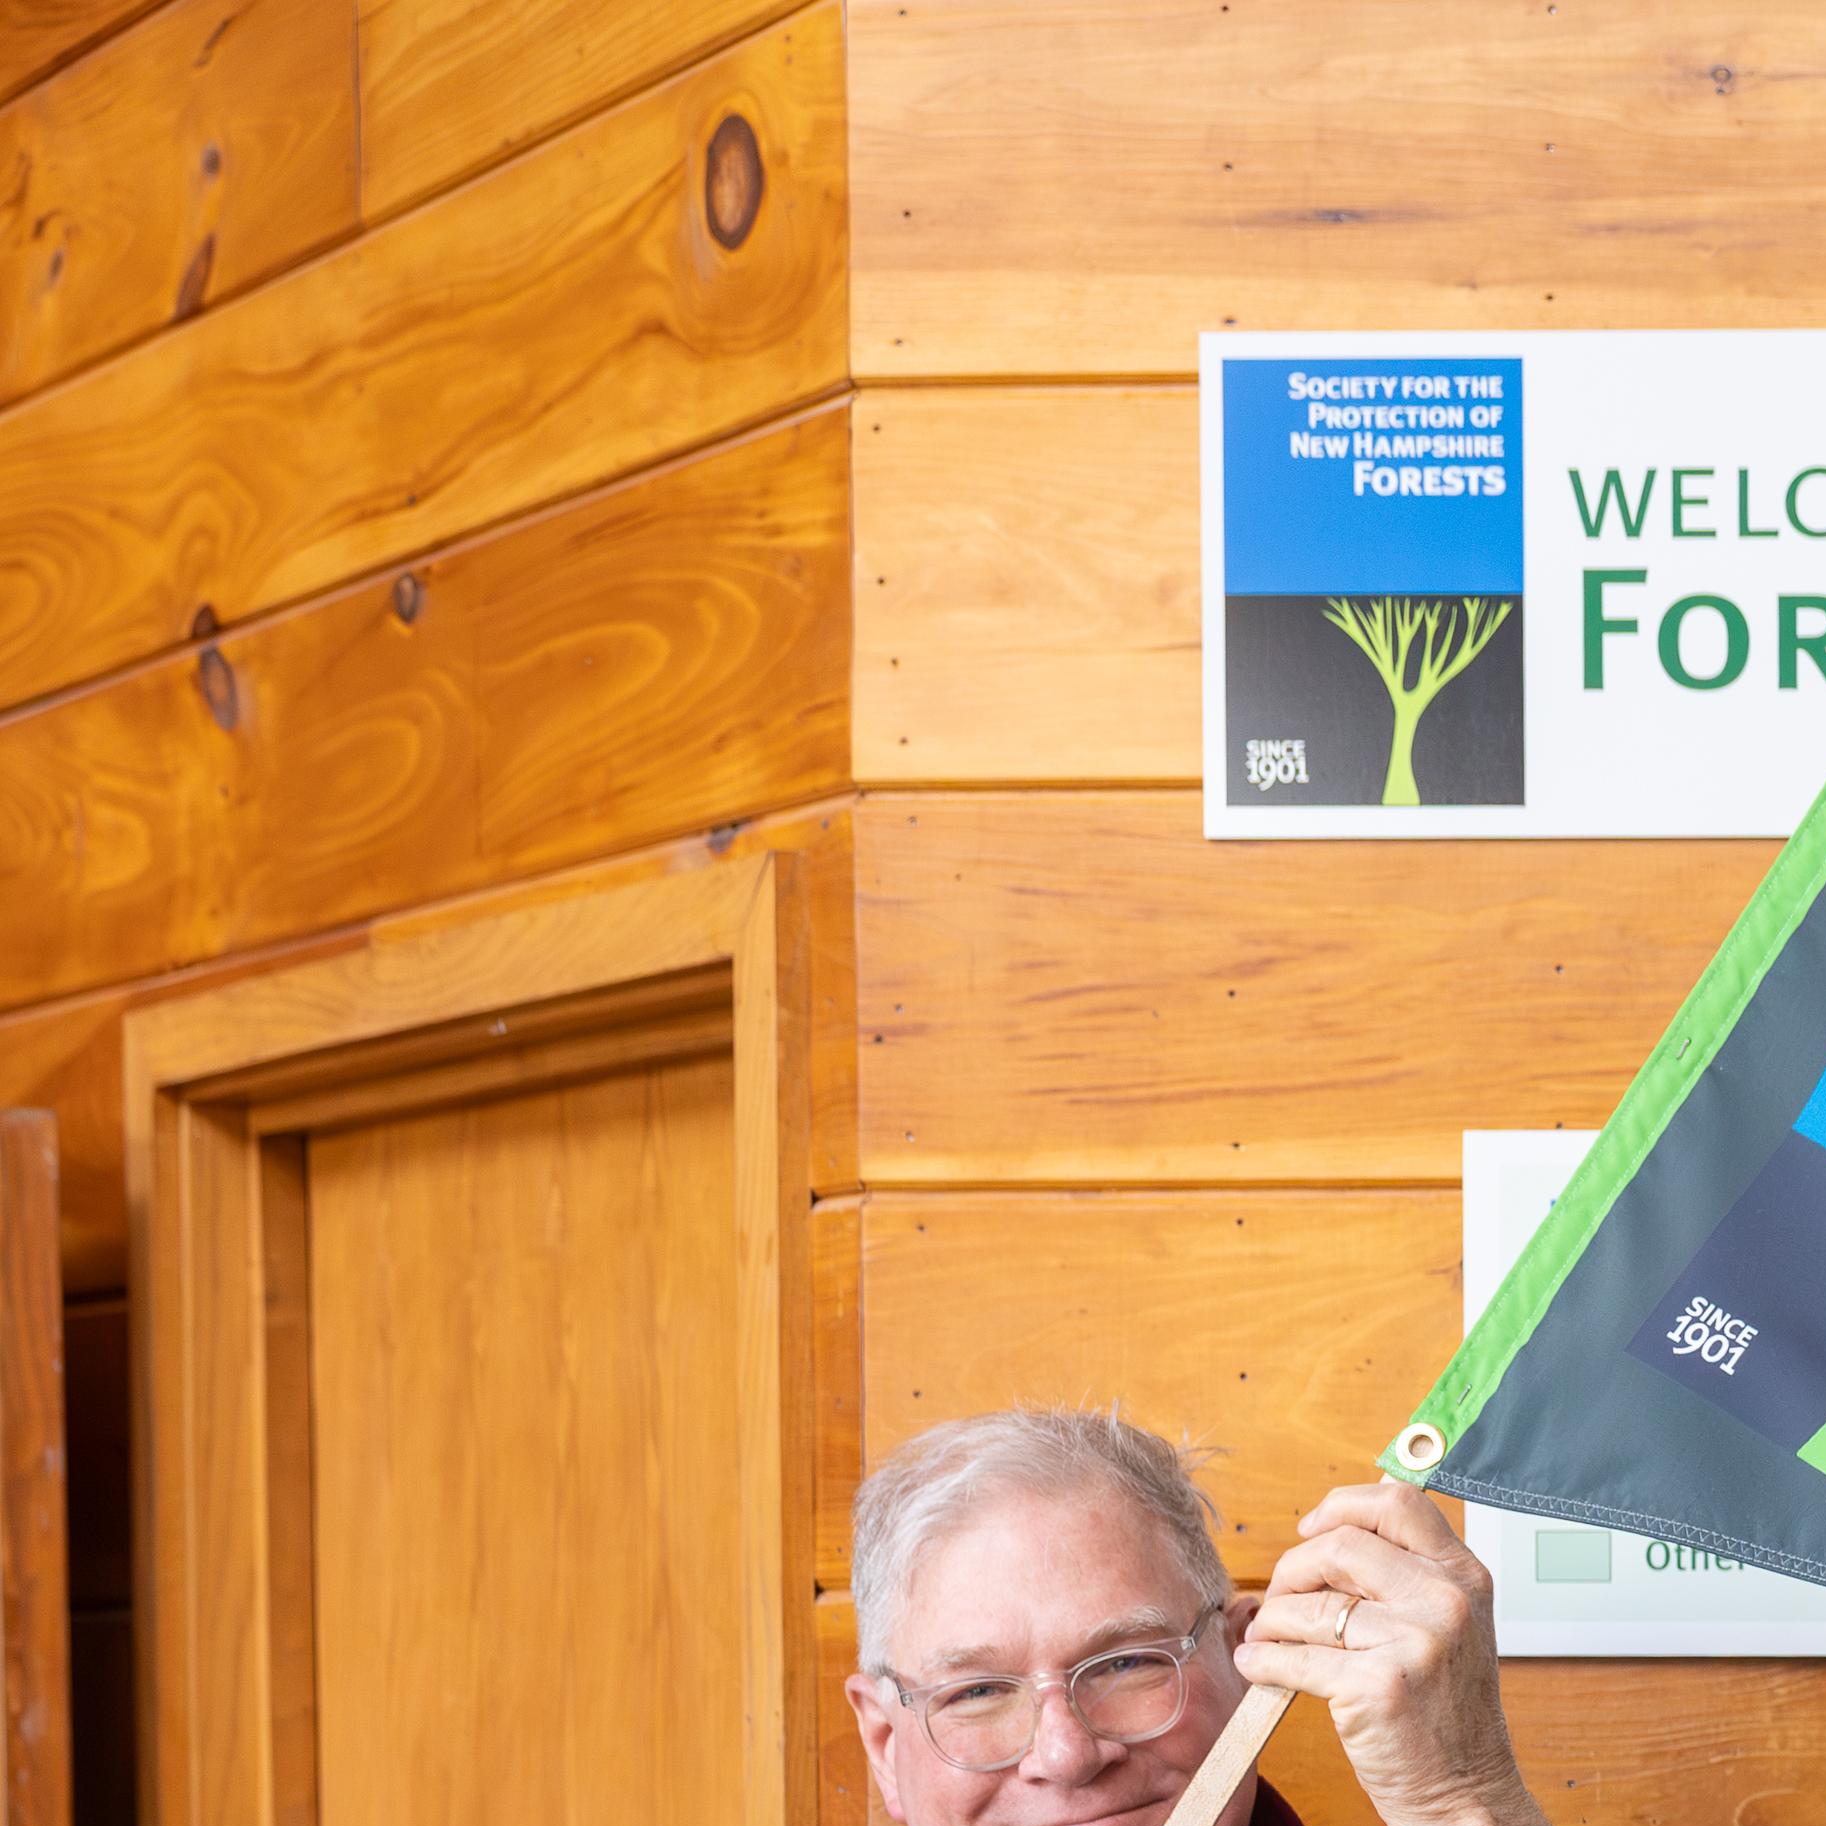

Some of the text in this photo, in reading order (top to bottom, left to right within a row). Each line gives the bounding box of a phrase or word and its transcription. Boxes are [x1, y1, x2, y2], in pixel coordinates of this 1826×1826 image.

[1288, 371, 1504, 400] SOCIETY FOR THE
[1308, 401, 1504, 430] PROTECTION OF
[1290, 430, 1505, 459] NEW HAMPSHIRE
[1353, 460, 1507, 497] FORESTS
[1245, 738, 1307, 758] SINCE
[1244, 756, 1310, 792] 1901
[1684, 1296, 1759, 1348] SINCE
[1666, 1314, 1746, 1376] 1901
